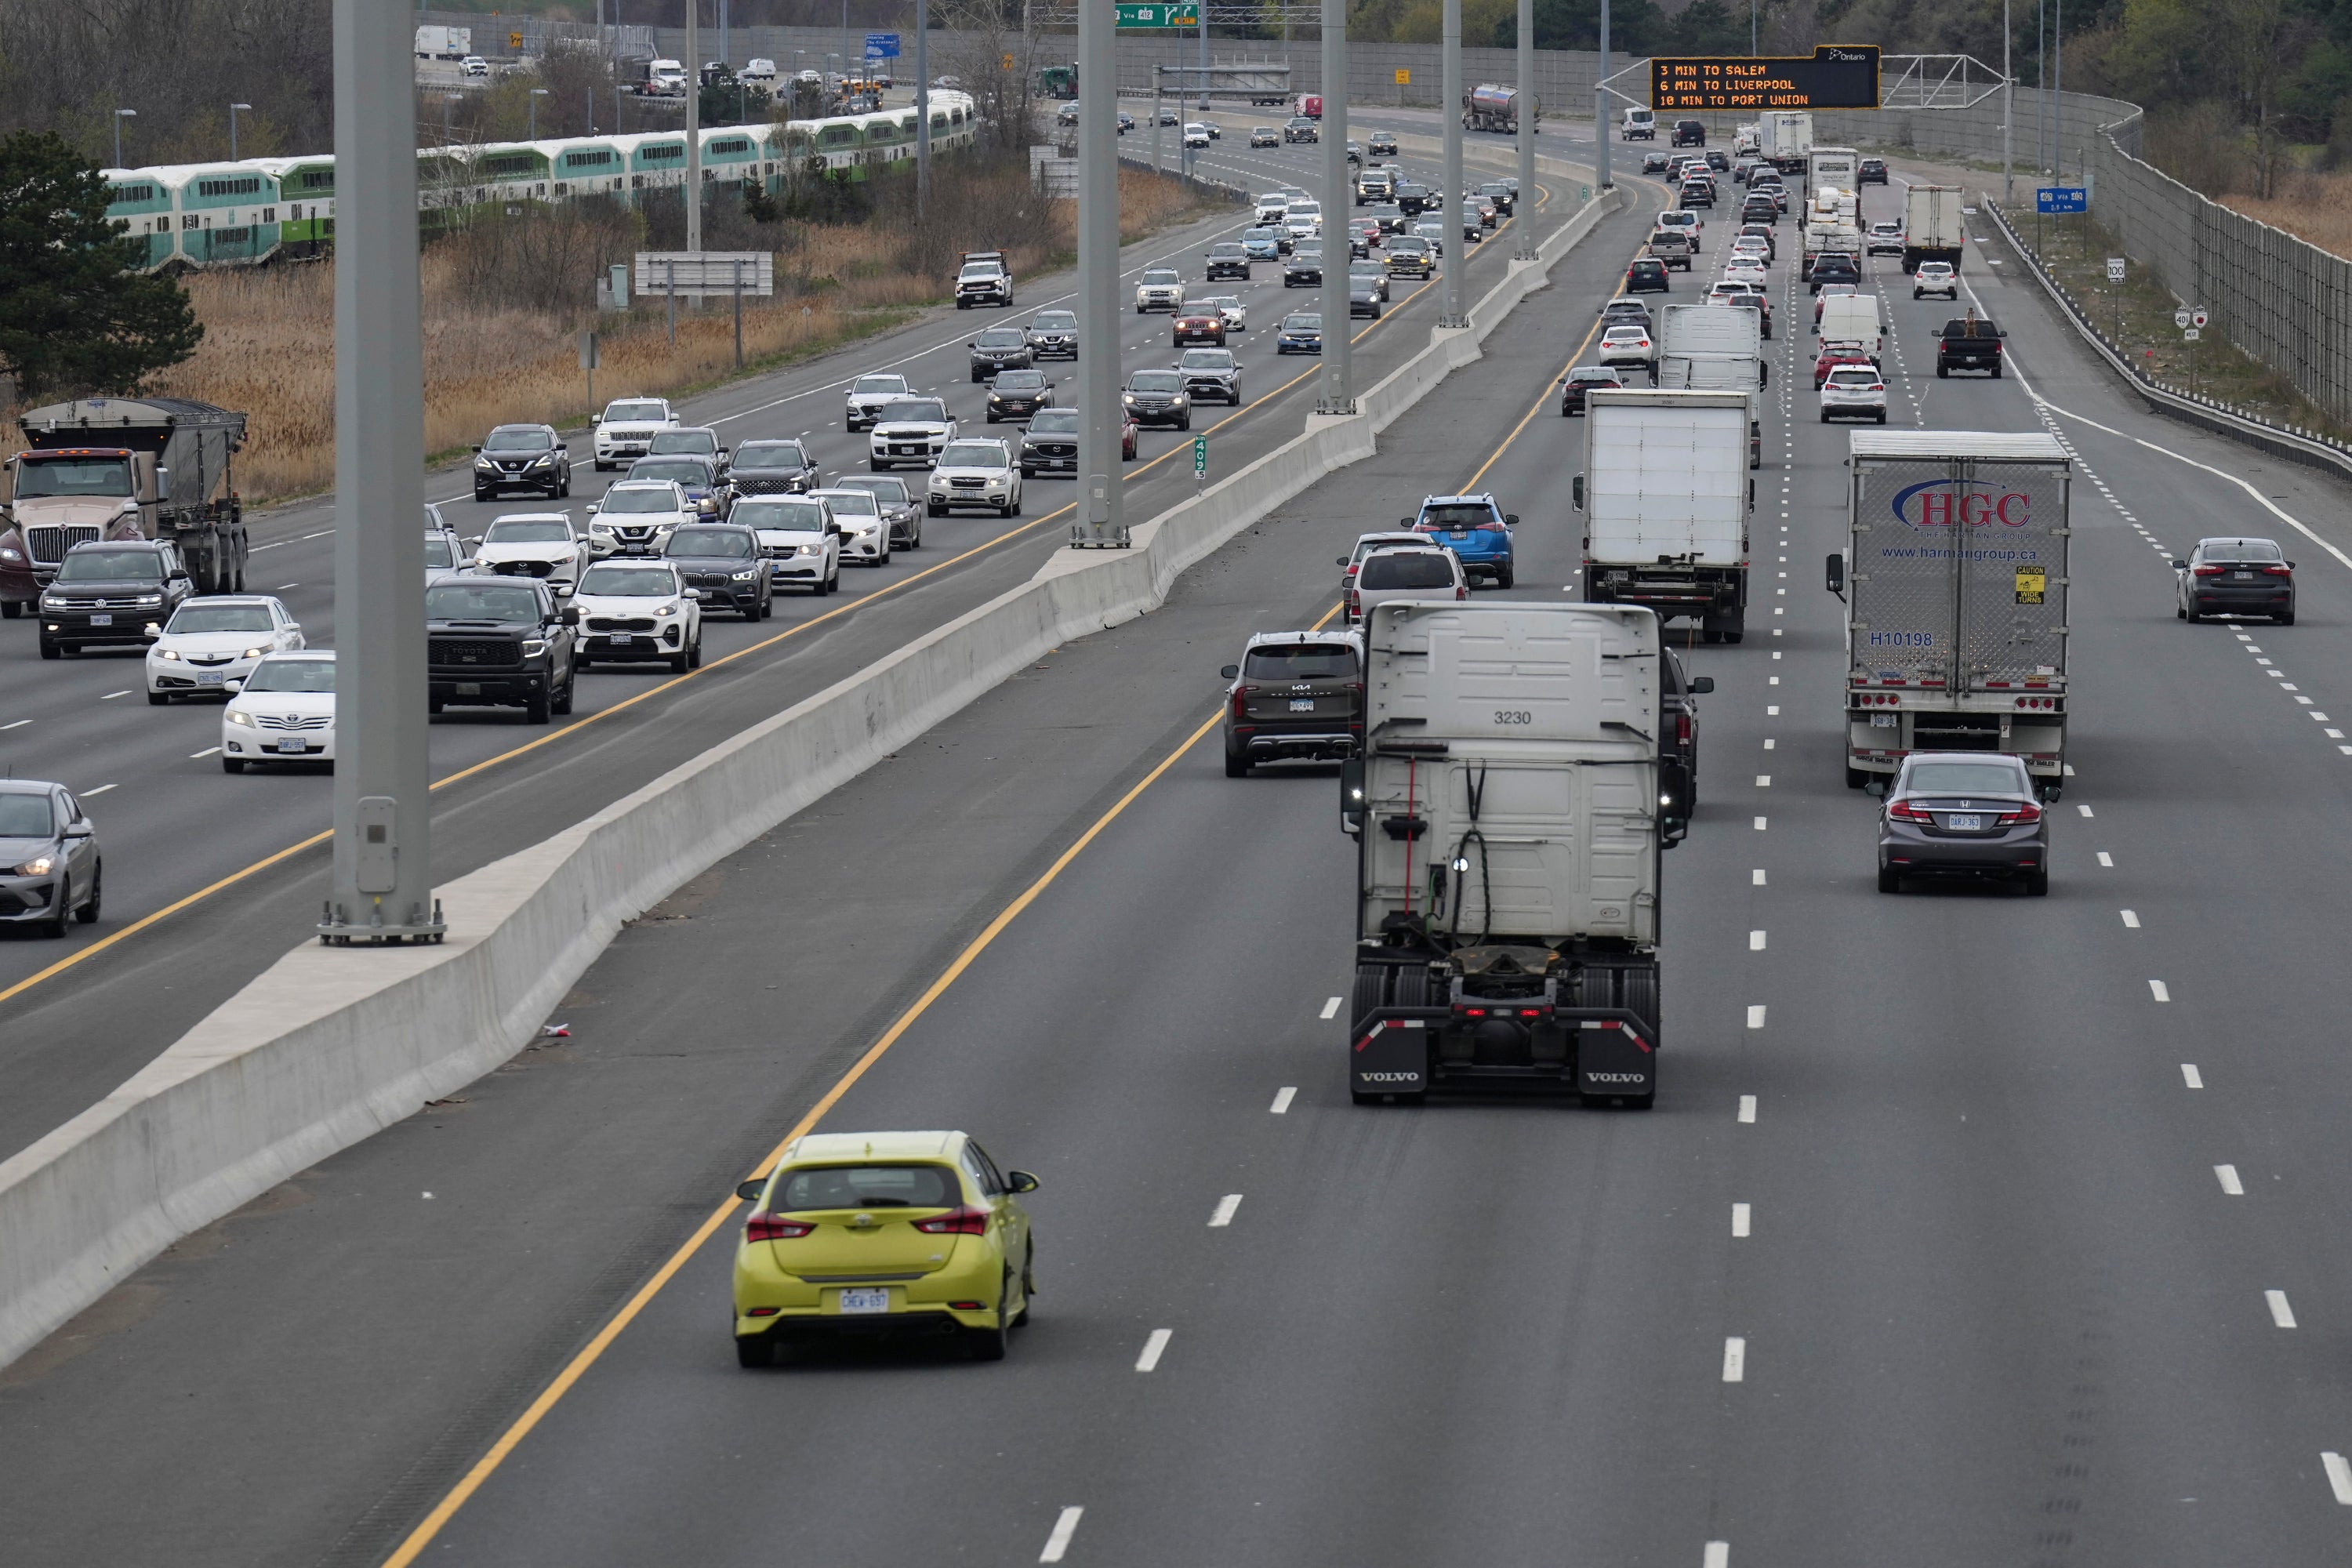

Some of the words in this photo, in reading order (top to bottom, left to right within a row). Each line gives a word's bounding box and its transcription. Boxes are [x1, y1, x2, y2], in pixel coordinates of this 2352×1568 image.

[1661, 66, 1668, 75] 3
[1675, 66, 1697, 75] MIN
[1704, 66, 1719, 75] TO
[1726, 65, 1766, 75] SALEM
[1661, 81, 1668, 90] 6
[1675, 81, 1697, 90] MIN
[1704, 81, 1719, 90] TO
[1726, 80, 1795, 90] LIVERPOOL
[1661, 96, 1674, 106] 10
[1681, 96, 1703, 105] MIN
[1709, 96, 1725, 105] TO
[1731, 96, 1762, 105] PORT
[1769, 95, 1809, 105] UNION
[2109, 267, 2124, 275] 100
[1918, 493, 2030, 527] HGC
[1882, 547, 2037, 562] www.harmangroup.ca
[1870, 632, 1933, 646] H10198
[1494, 710, 1531, 724] 3230
[1359, 1072, 1419, 1082] VOLVO
[1586, 1072, 1645, 1083] VOLVO
